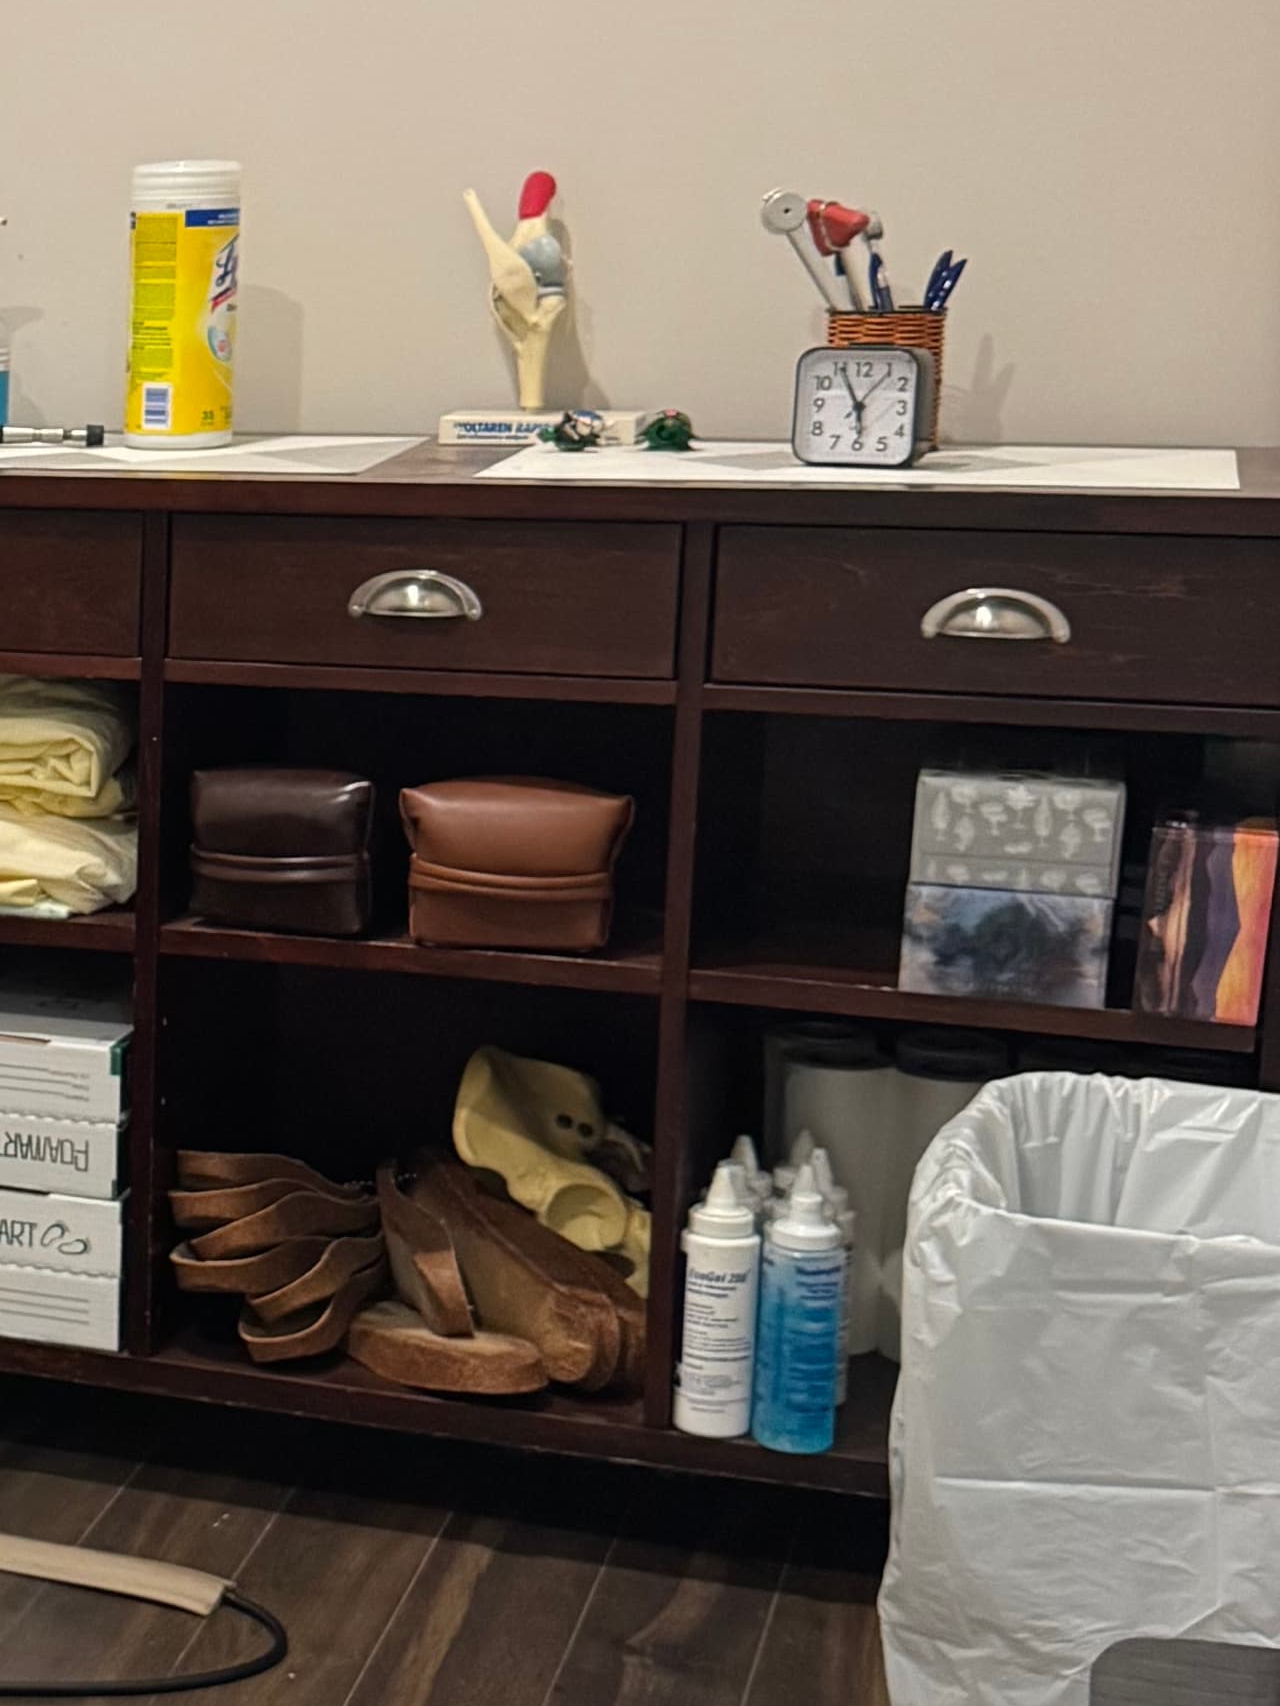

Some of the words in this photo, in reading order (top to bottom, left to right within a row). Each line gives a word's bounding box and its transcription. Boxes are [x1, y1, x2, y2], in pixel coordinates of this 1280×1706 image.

[855, 361, 874, 378] 12
[814, 375, 832, 391] 10
[897, 376, 909, 392] 2
[813, 397, 825, 413] 9
[896, 399, 908, 416] 3
[811, 420, 824, 437] 8
[894, 424, 905, 438] 4
[829, 434, 842, 450] 7
[851, 435, 864, 452] 6
[875, 436, 888, 452] 5
